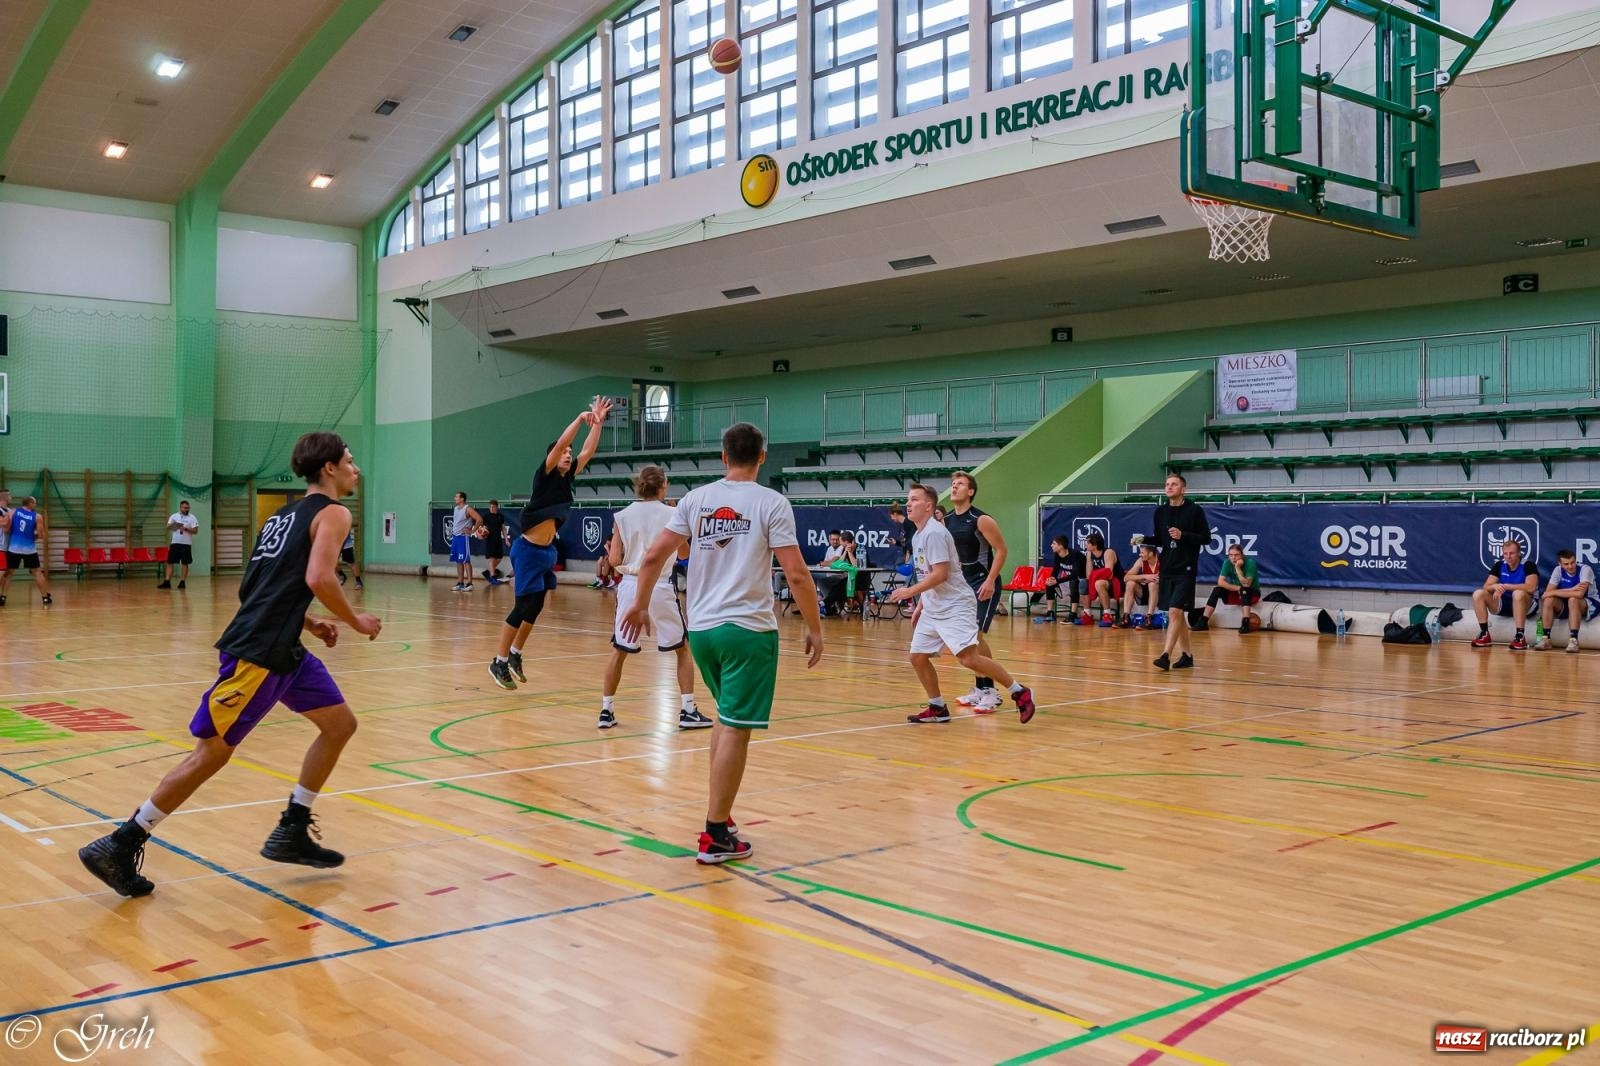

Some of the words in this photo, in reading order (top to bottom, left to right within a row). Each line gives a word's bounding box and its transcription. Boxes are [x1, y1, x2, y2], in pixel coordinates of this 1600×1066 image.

[786, 140, 878, 186] OŚRODEK
[885, 115, 972, 162] SPORTU
[980, 112, 988, 140] I
[995, 74, 1134, 136] REKREACJI
[775, 363, 787, 371] A
[1228, 353, 1287, 371] MIESZKO
[251, 511, 296, 561] 23
[1320, 525, 1407, 557] OSiR
[1354, 557, 1407, 569] RACIBÓRZ
